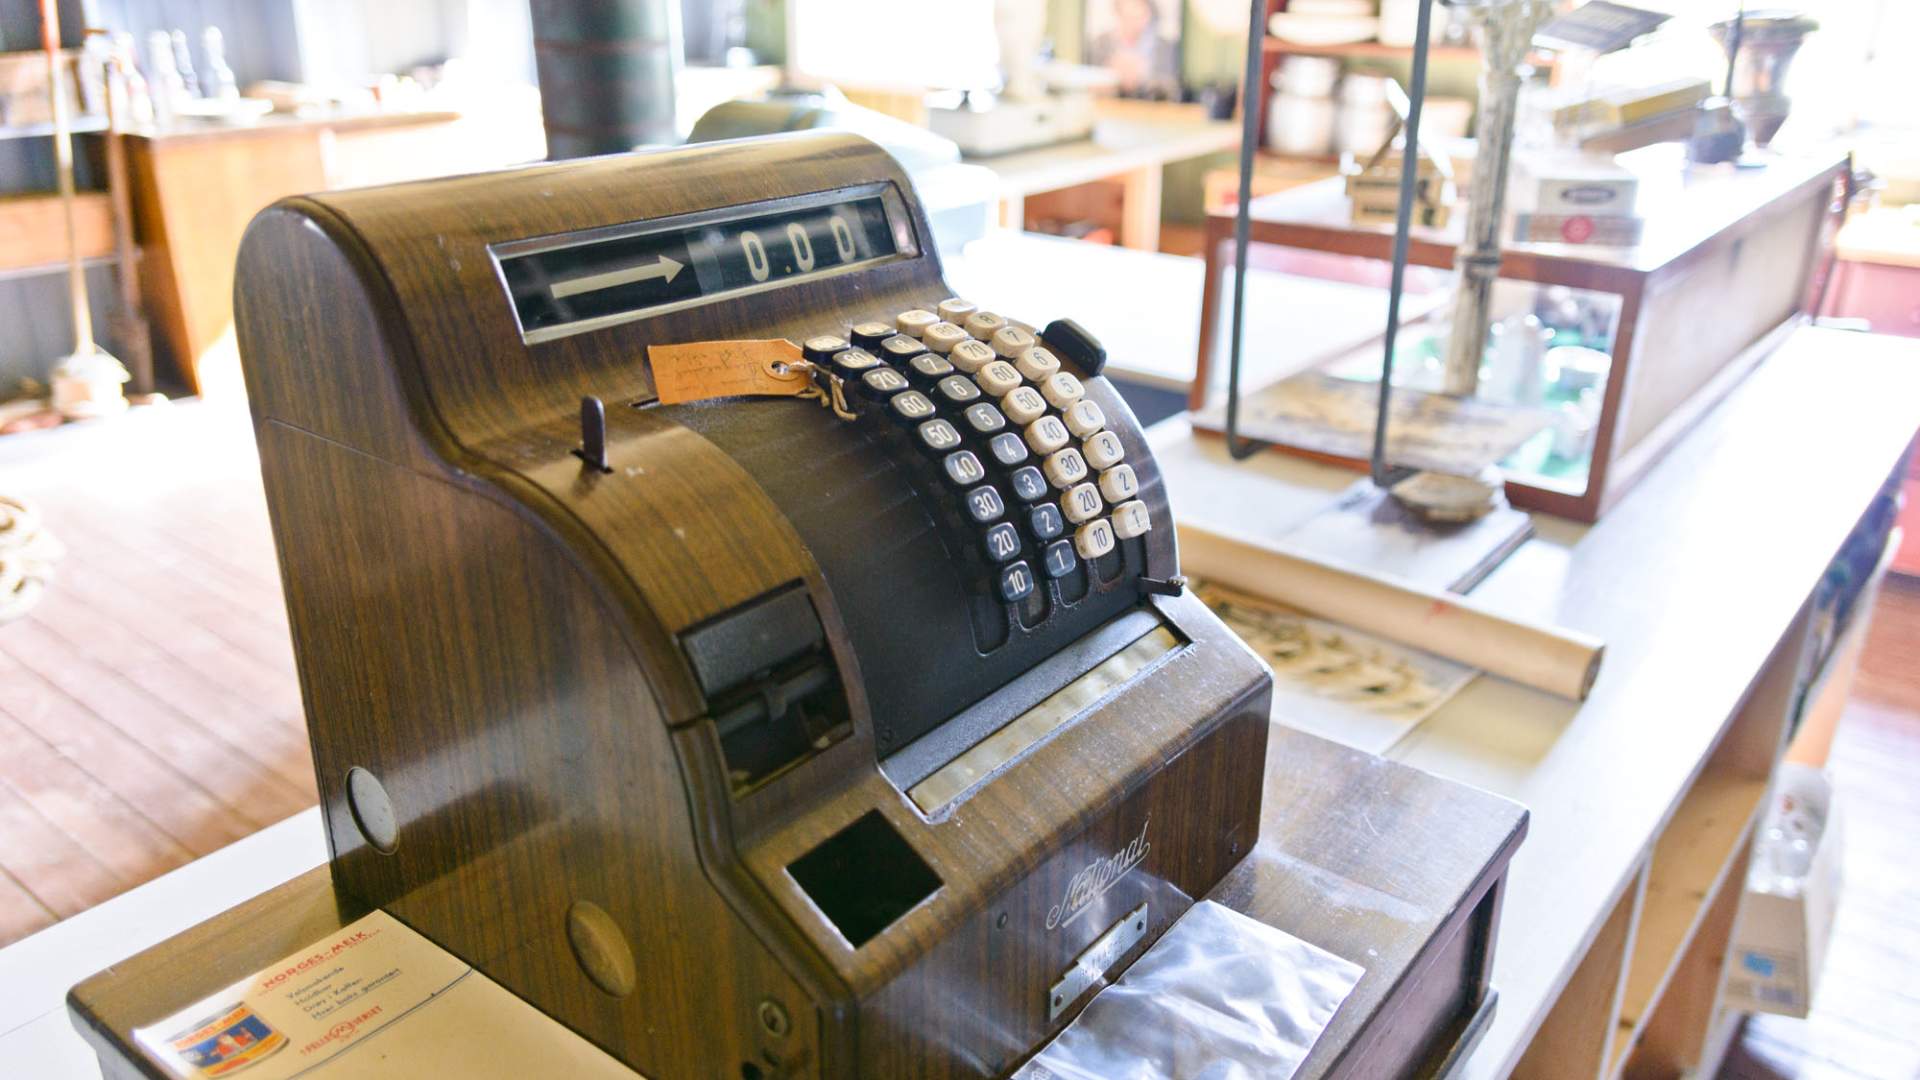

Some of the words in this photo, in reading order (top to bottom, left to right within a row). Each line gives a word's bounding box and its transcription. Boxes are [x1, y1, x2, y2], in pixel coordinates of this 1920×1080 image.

[1006, 330, 1017, 343] 7
[963, 344, 987, 359] 70
[1034, 352, 1048, 366] 6
[927, 357, 938, 370] 7
[875, 370, 900, 389] 70
[992, 368, 1015, 383] 60
[1062, 377, 1073, 393] 5
[953, 381, 965, 396] 6
[900, 396, 927, 416] 60
[1018, 389, 1039, 409] 50
[980, 409, 991, 426] 5
[927, 425, 952, 445] 50
[1042, 421, 1061, 441] 40
[1003, 440, 1016, 458] 4
[1102, 439, 1114, 456] 3
[953, 457, 976, 477] 40
[1061, 454, 1080, 477] 30
[1024, 474, 1034, 492] 3
[1118, 472, 1129, 490] 2
[974, 492, 995, 515] 30
[1078, 493, 1096, 512] 20
[1041, 511, 1054, 532] 2
[1131, 508, 1140, 527] 1
[994, 530, 1014, 554] 20
[1093, 530, 1107, 548] 10
[1055, 550, 1065, 570] 1
[1008, 569, 1025, 593] 10
[1046, 811, 1151, 930] National
[263, 931, 368, 988] NORGES-MELK
